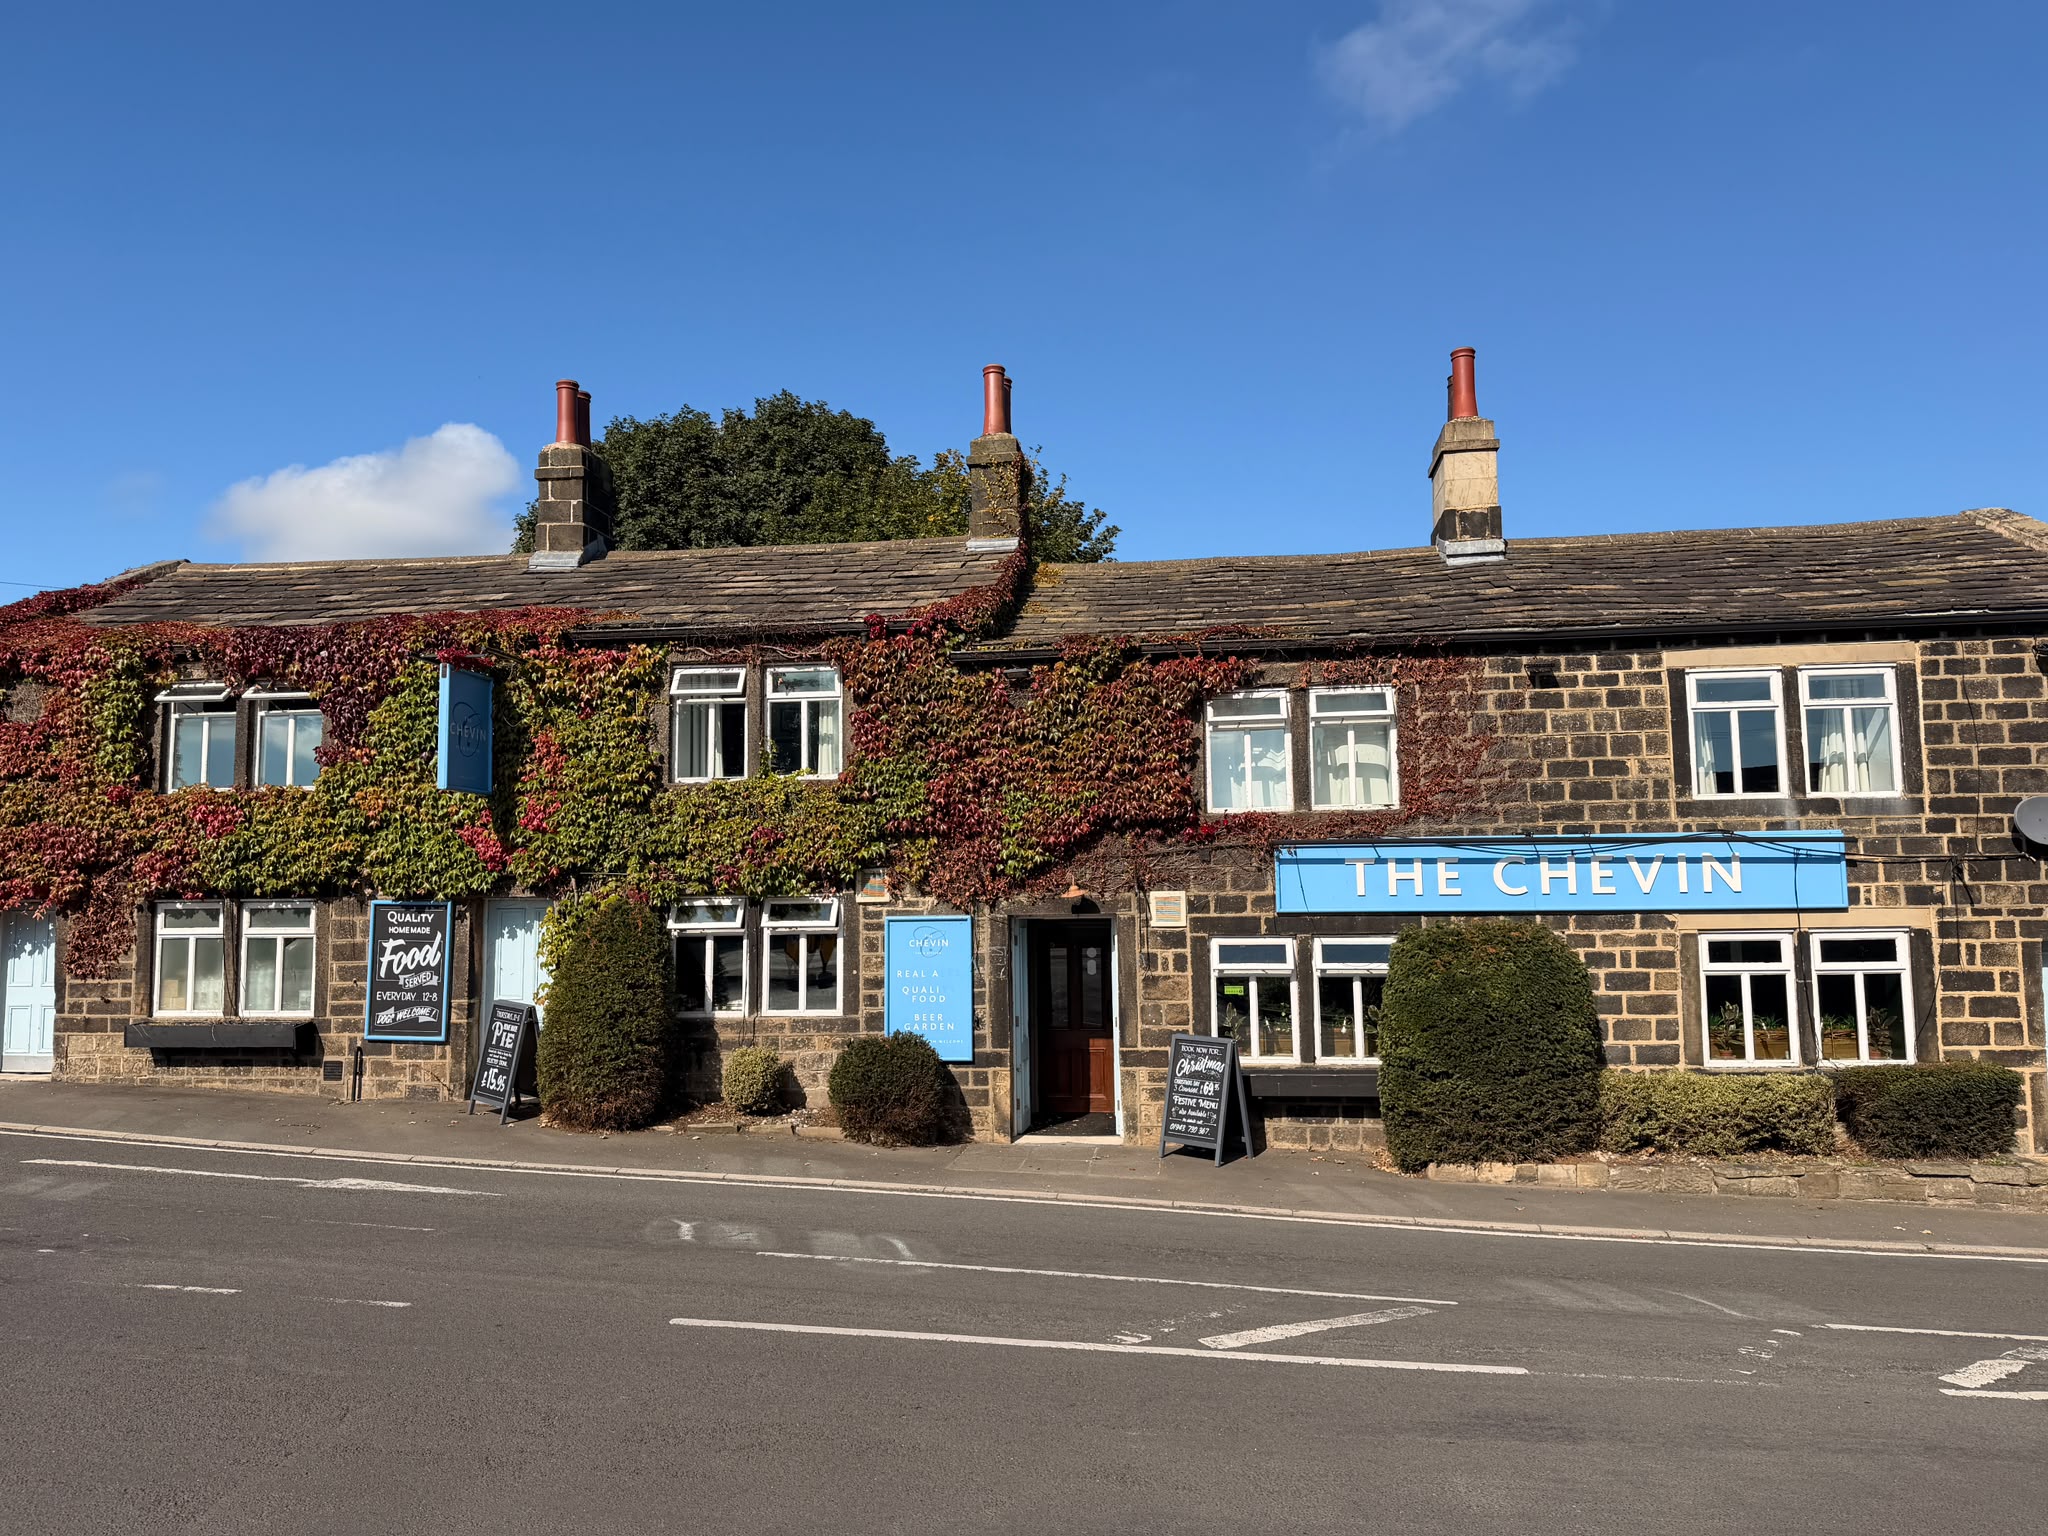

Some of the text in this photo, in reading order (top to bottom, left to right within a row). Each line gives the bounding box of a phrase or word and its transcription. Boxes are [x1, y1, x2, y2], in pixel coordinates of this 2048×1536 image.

[450, 722, 487, 742] CHEVIN
[1345, 853, 1742, 896] THE CHEVIN
[388, 926, 431, 934] HOME MADE
[909, 939, 949, 947] CHEVIN
[380, 930, 442, 978] Food
[897, 970, 926, 978] REAL
[405, 972, 431, 988] SERVED
[422, 992, 438, 1002] 12-8
[912, 995, 946, 1003] FOOD
[914, 1013, 943, 1021] BEER
[904, 1023, 955, 1031] GARDEN
[491, 1021, 516, 1049] PIE
[1181, 1045, 1195, 1053] BOOK
[1175, 1055, 1225, 1077] Christmas
[480, 1067, 507, 1092] £15.95
[1173, 1084, 1178, 1092] 3
[1172, 1095, 1219, 1110] FESTIVE MENU
[1169, 1122, 1187, 1132] 01943
[1187, 1125, 1198, 1134] 730
